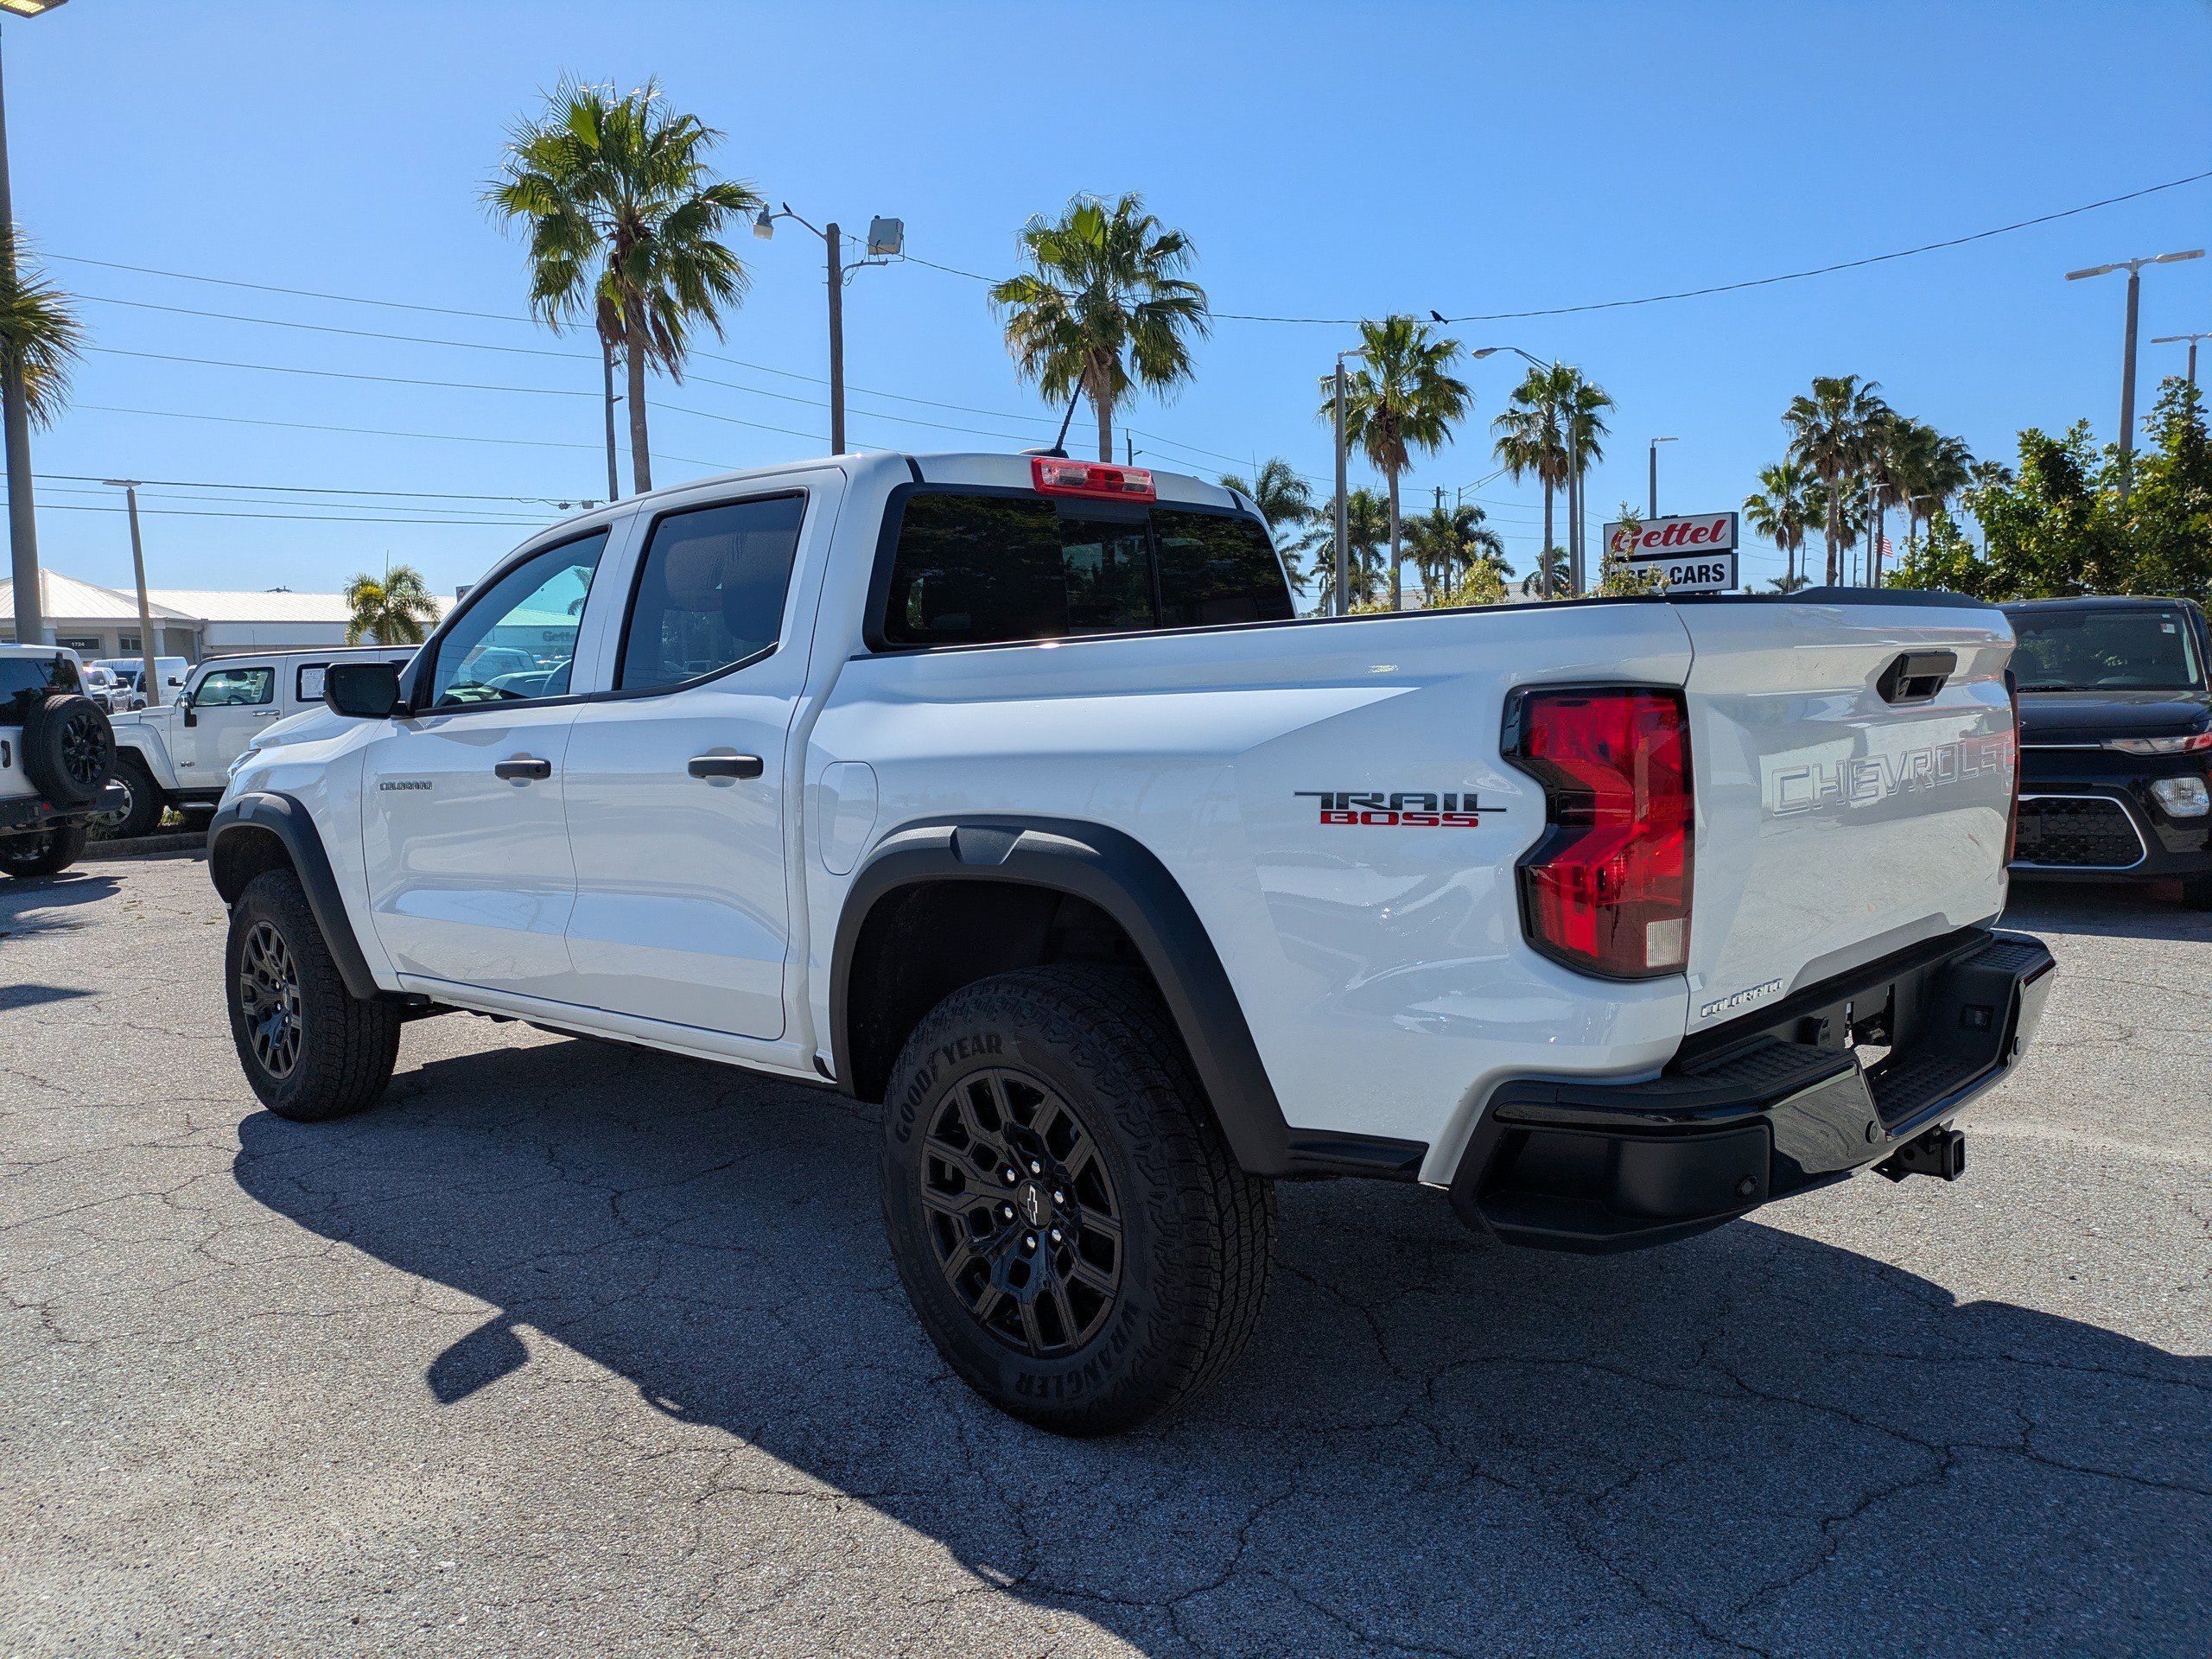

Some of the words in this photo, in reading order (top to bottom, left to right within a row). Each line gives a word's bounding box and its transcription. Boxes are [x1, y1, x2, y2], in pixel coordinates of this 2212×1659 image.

[1611, 519, 1726, 552] Gettel
[1669, 563, 1725, 585] CARS
[379, 780, 432, 791] COLORADO
[1294, 791, 1507, 811] TRAIL
[1319, 810, 1479, 827] BOSS
[1700, 977, 1783, 1018] COLORADO
